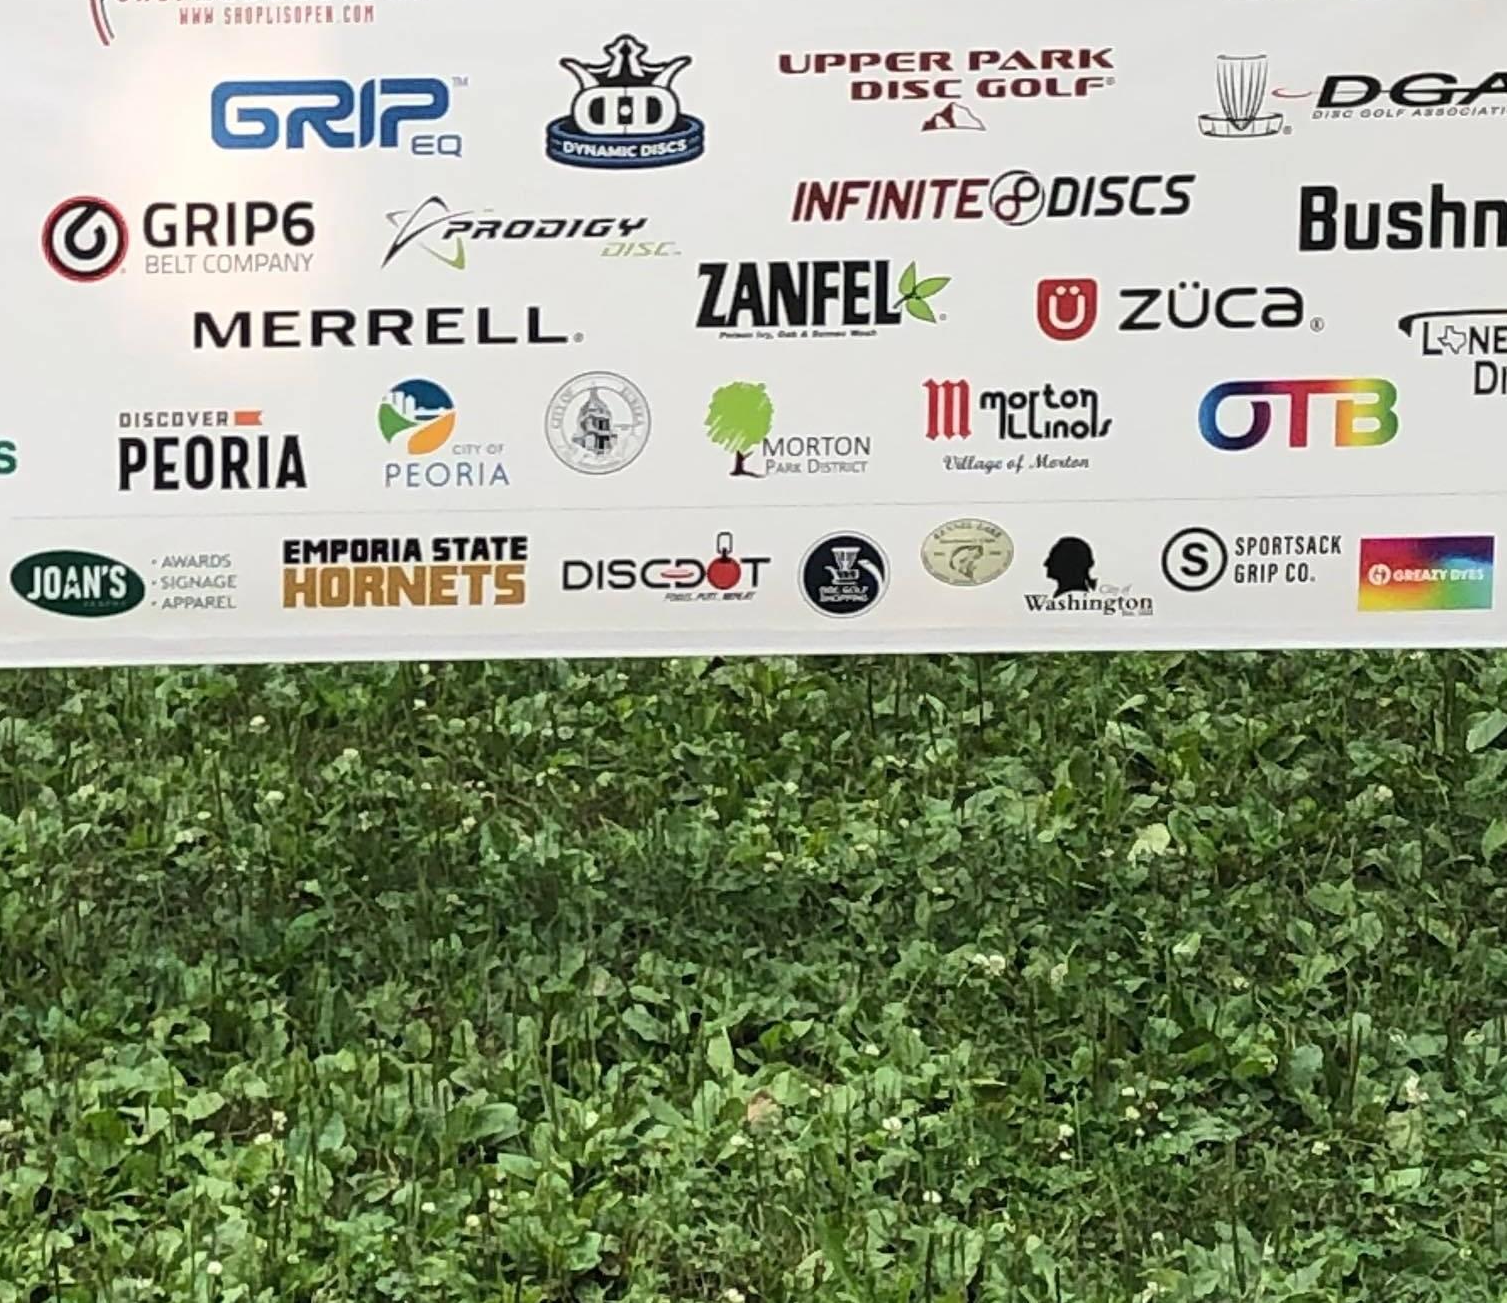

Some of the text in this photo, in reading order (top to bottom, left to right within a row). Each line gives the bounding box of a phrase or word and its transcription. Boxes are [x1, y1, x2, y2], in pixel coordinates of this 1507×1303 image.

[779, 48, 1114, 74] UPPER PARK
[851, 76, 1105, 101] DISC GOLF
[1316, 72, 1507, 108] DGA
[211, 78, 450, 150] GRIP
[1312, 110, 1354, 119] DISC
[1360, 108, 1406, 119] GOLF
[412, 135, 462, 158] EQ
[563, 139, 687, 157] DYNAMIC DISCS
[792, 174, 1196, 222] INFINITE DISCS
[144, 202, 315, 248] GRIP6
[442, 218, 648, 240] PRODIGY
[145, 253, 313, 274] BELT COMPANY
[696, 260, 902, 328] ZANFEL
[194, 307, 568, 349] MERRELL
[119, 410, 229, 429] DISCOVER
[1198, 378, 1399, 451] OTB
[452, 444, 504, 455] CITY OF
[763, 437, 871, 457] MORTON
[118, 435, 307, 491] PEORIA
[943, 454, 1090, 474] Village of Morton
[384, 462, 511, 488] PEORIA
[283, 536, 528, 564] EMPORIA STATE
[1235, 536, 1341, 556] SPORTSACK
[161, 554, 232, 568] AWARDS
[26, 565, 127, 600] JOAN'S
[161, 575, 237, 590] SIGNAGE
[1234, 563, 1315, 583] GRIP CO.
[282, 564, 526, 609] HORNETS
[161, 596, 237, 609] APPAREL
[1024, 593, 1153, 615] Washington
